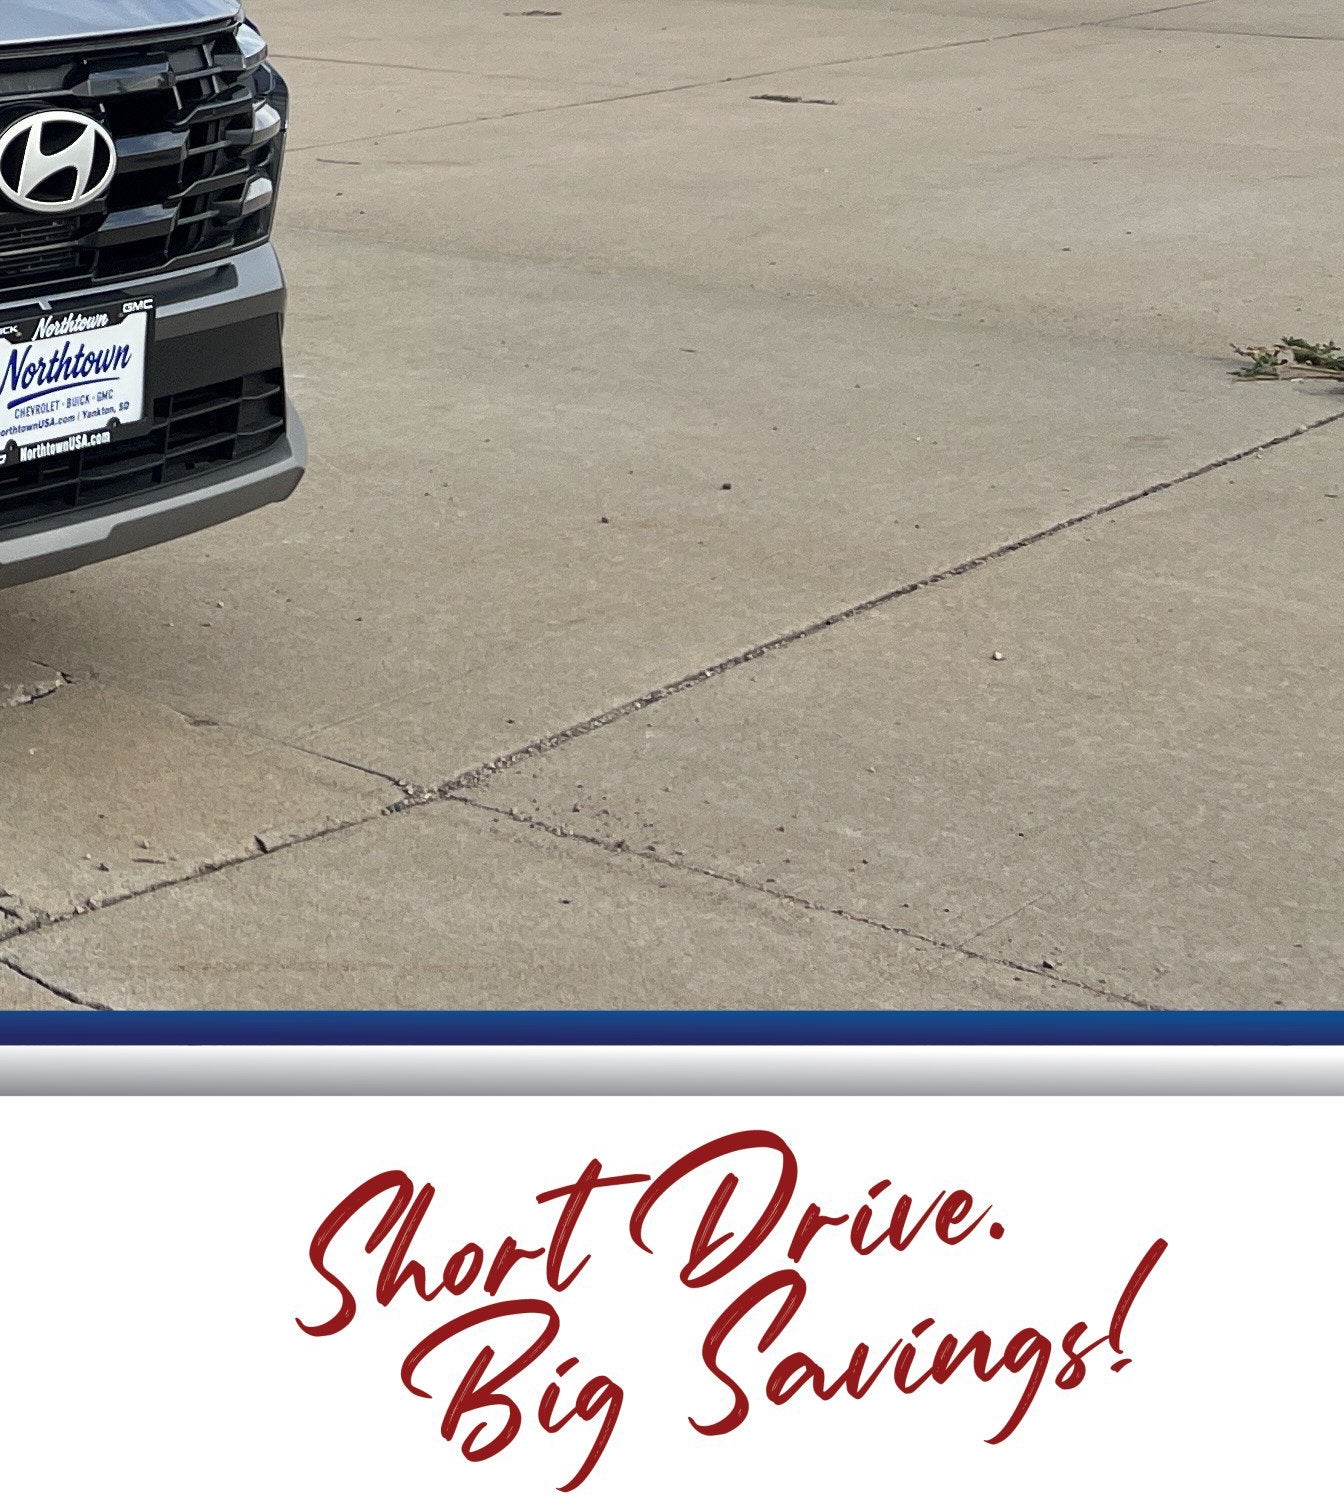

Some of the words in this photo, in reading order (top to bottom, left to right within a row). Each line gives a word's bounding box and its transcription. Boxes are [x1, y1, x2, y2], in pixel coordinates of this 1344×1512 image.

[122, 299, 154, 314] GMC
[31, 312, 109, 341] Northtown
[14, 399, 60, 419] CHEVROLET
[66, 394, 90, 409] BUICK
[96, 389, 114, 402] GMC
[82, 406, 116, 419] Yankton,
[119, 400, 130, 411] SD
[19, 431, 111, 462] NorthtownUSA.com
